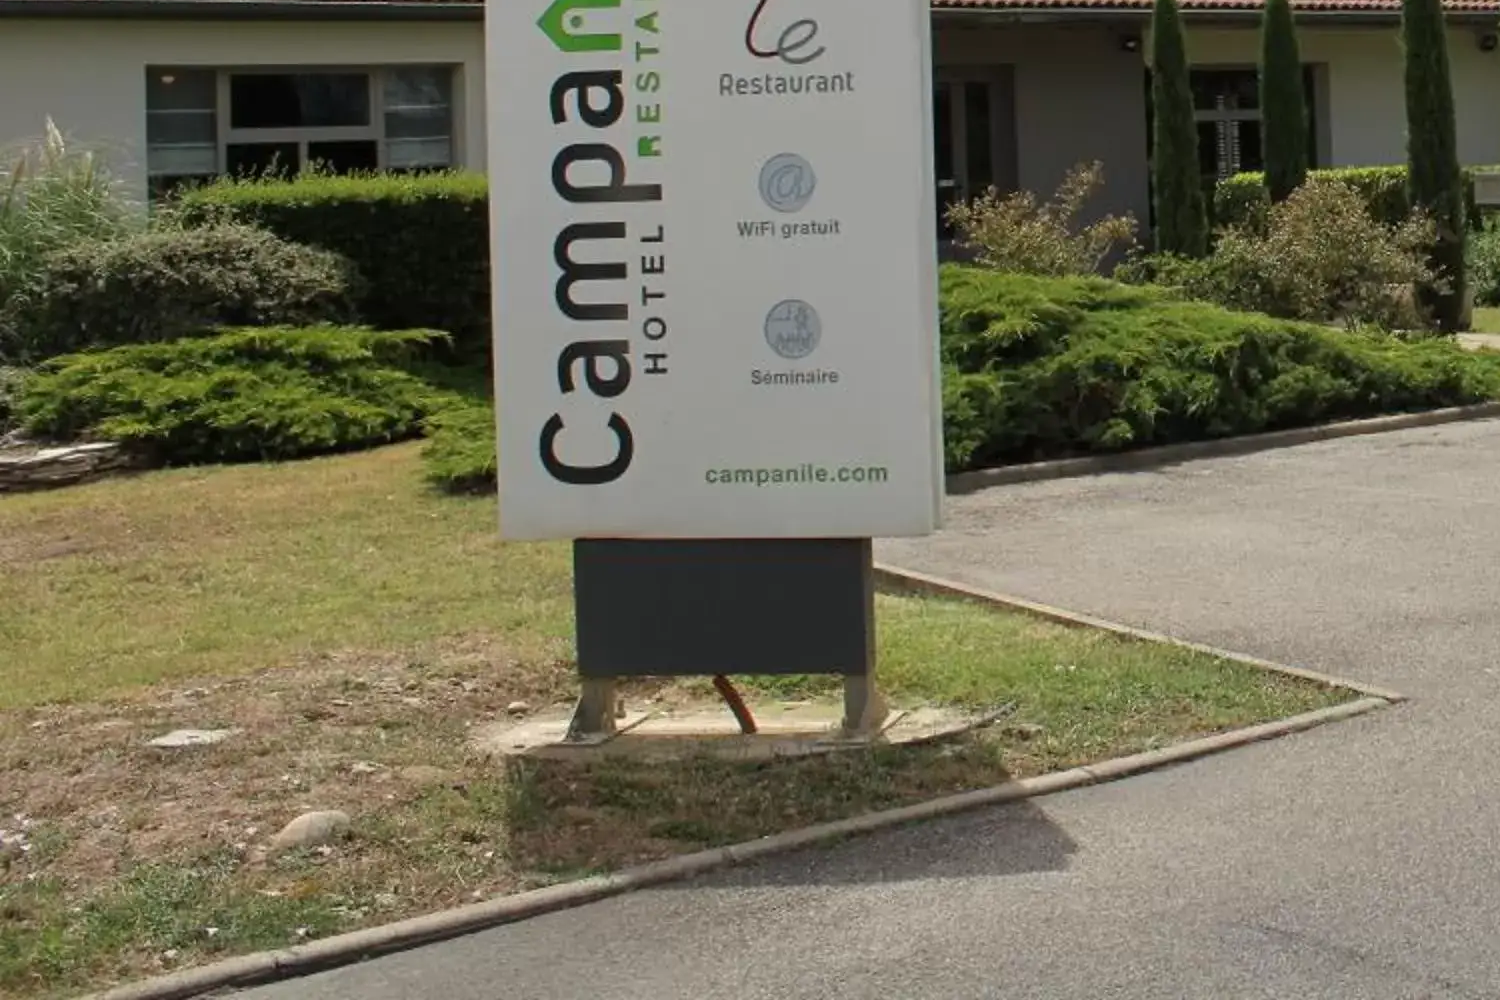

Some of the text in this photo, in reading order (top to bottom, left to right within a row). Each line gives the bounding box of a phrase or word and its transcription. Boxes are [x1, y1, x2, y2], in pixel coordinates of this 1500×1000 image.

[719, 71, 855, 96] Restaurant
[736, 220, 841, 239] WiFi gratuit
[640, 224, 667, 374] HOTEL
[705, 463, 889, 487] campanile.com
